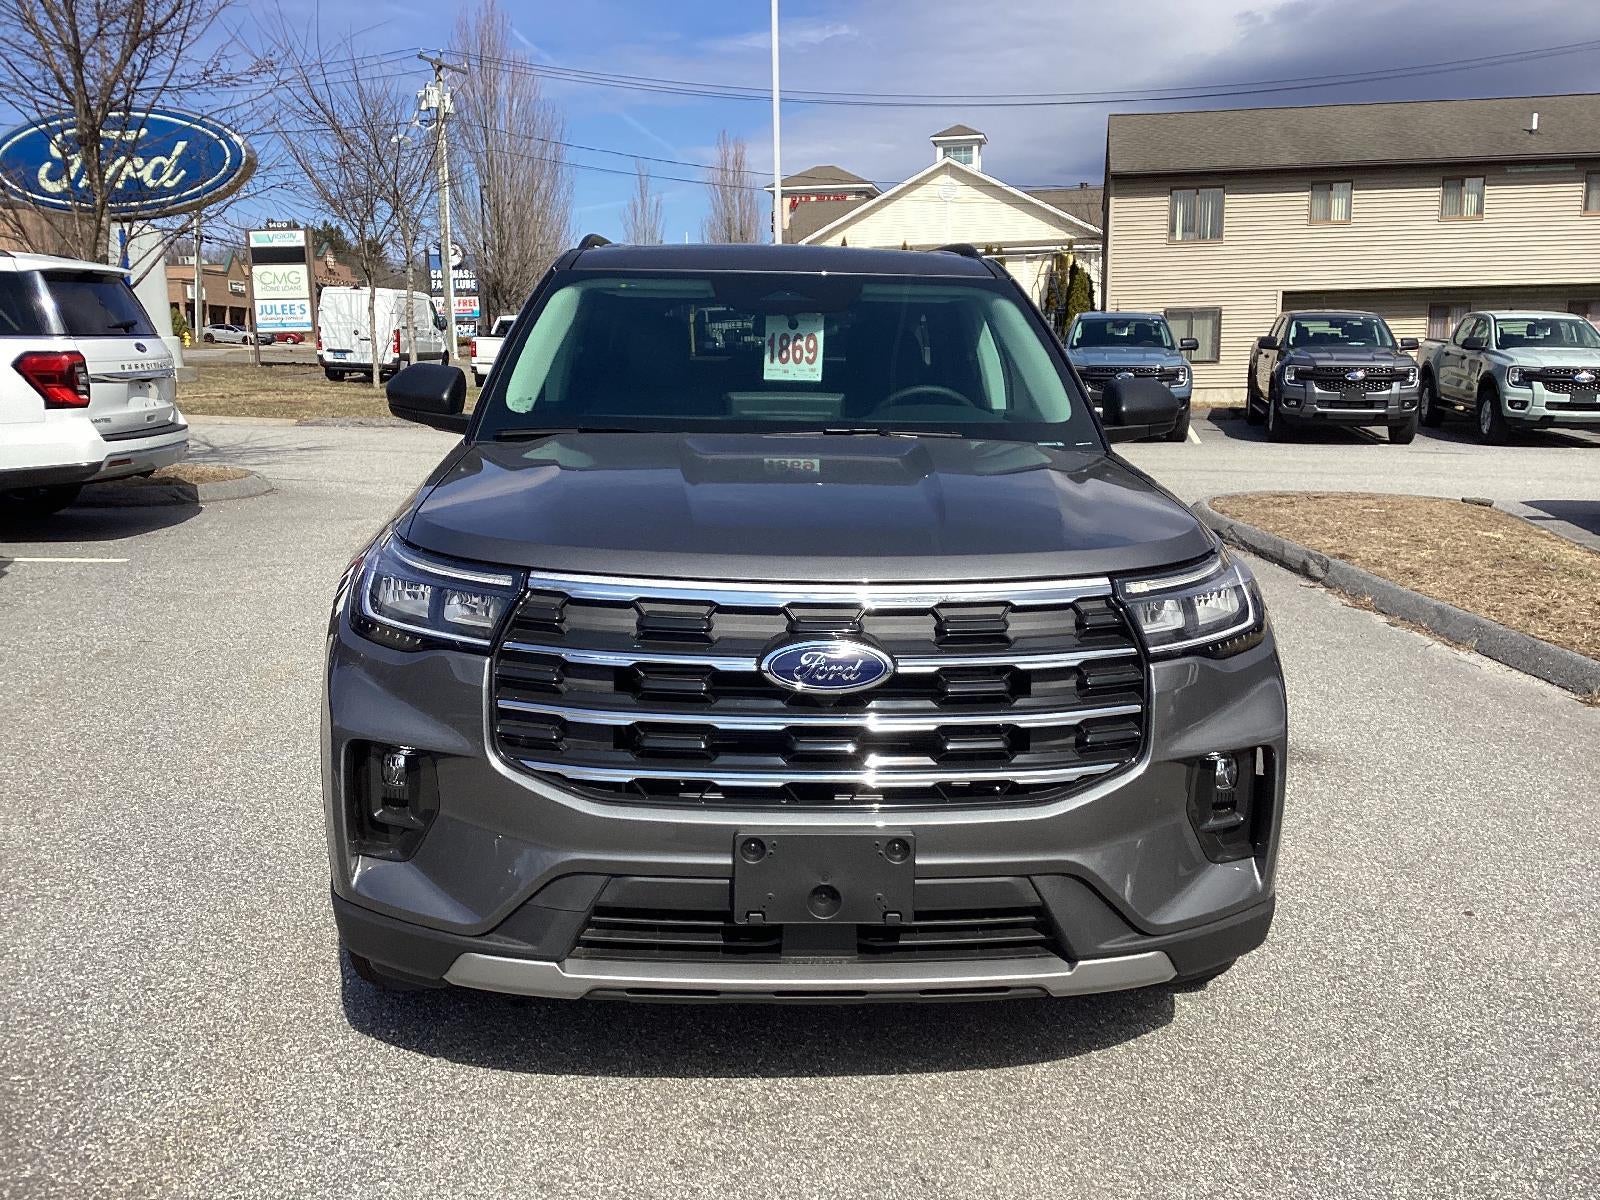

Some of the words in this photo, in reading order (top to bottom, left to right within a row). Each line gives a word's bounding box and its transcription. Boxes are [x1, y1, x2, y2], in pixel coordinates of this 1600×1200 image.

[38, 127, 188, 193] Frd
[260, 271, 301, 285] CMG
[430, 270, 444, 279] CA
[455, 280, 476, 289] LUBE
[259, 303, 306, 316] JULEE'S
[768, 332, 818, 365] 1869
[793, 650, 864, 681] Ford
